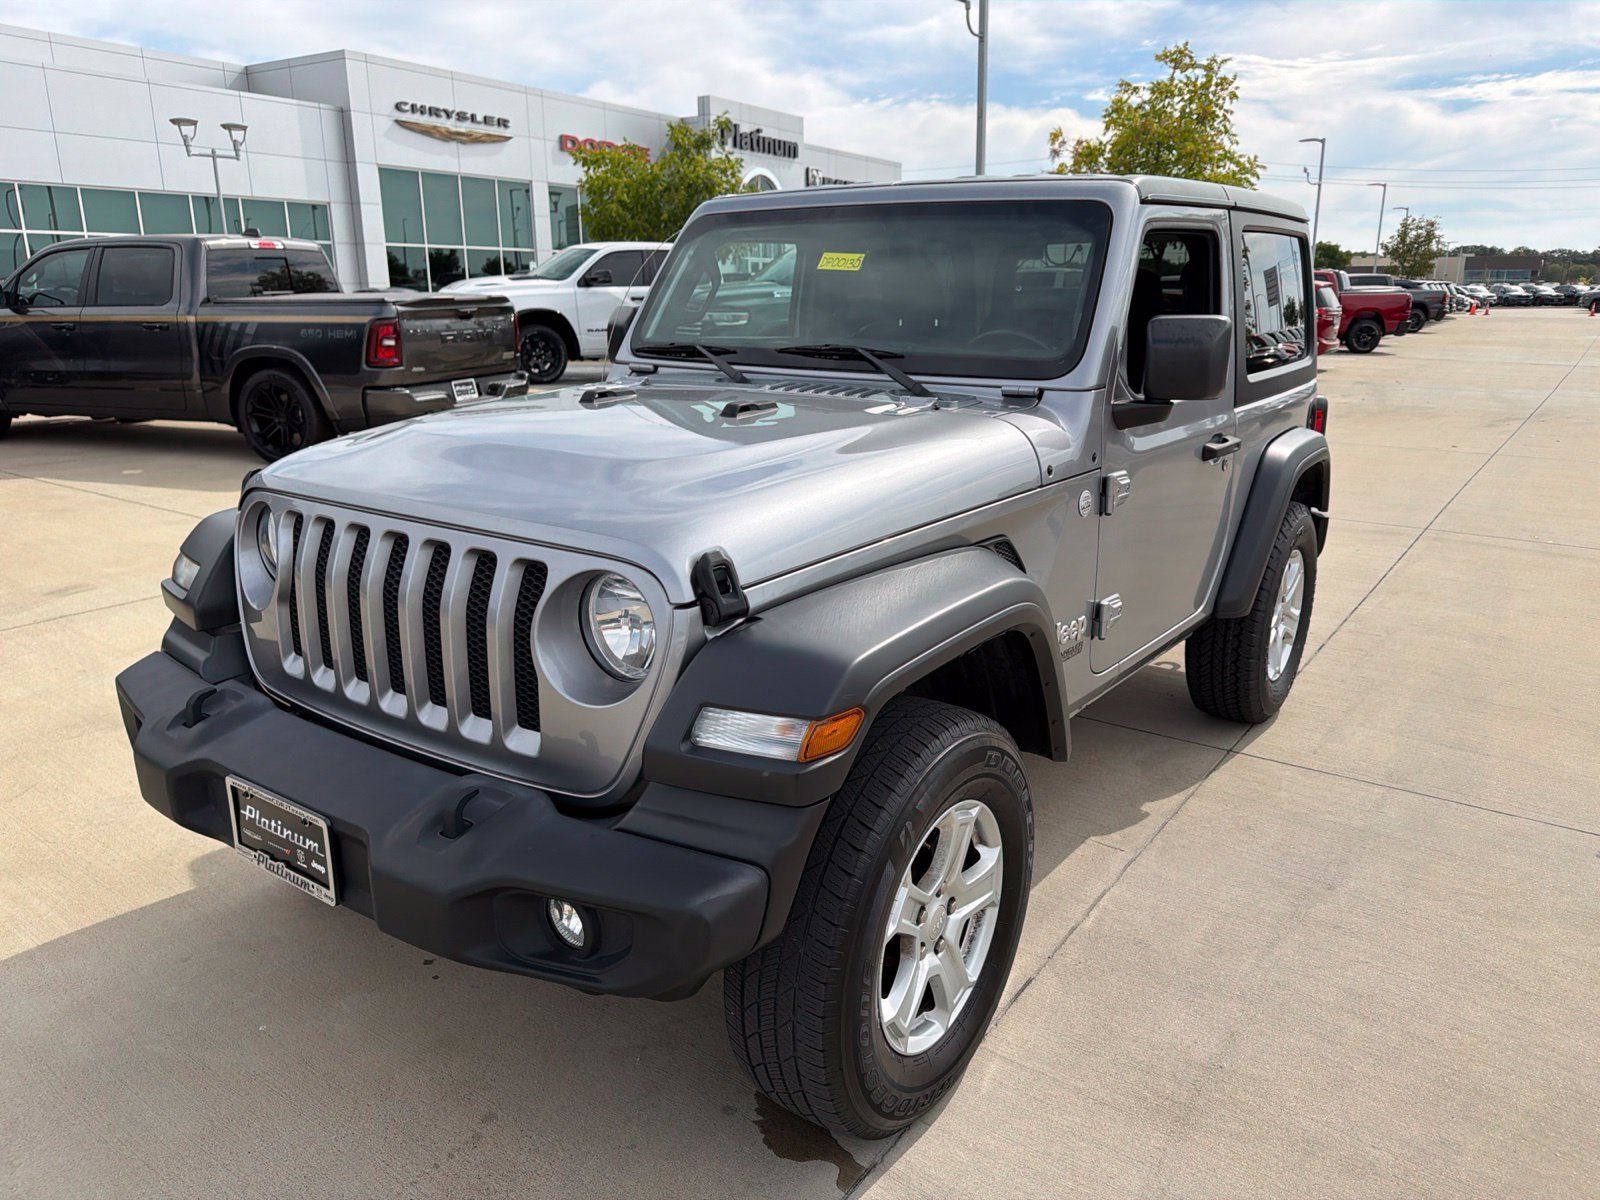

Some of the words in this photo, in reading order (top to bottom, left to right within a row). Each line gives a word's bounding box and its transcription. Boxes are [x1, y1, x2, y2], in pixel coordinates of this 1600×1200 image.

[395, 100, 511, 129] CHRYSLER
[719, 119, 799, 158] Platinum
[328, 329, 357, 339] HEMI
[1056, 615, 1087, 645] Jeep
[241, 804, 325, 858] Platinum
[256, 851, 316, 894] Platinum
